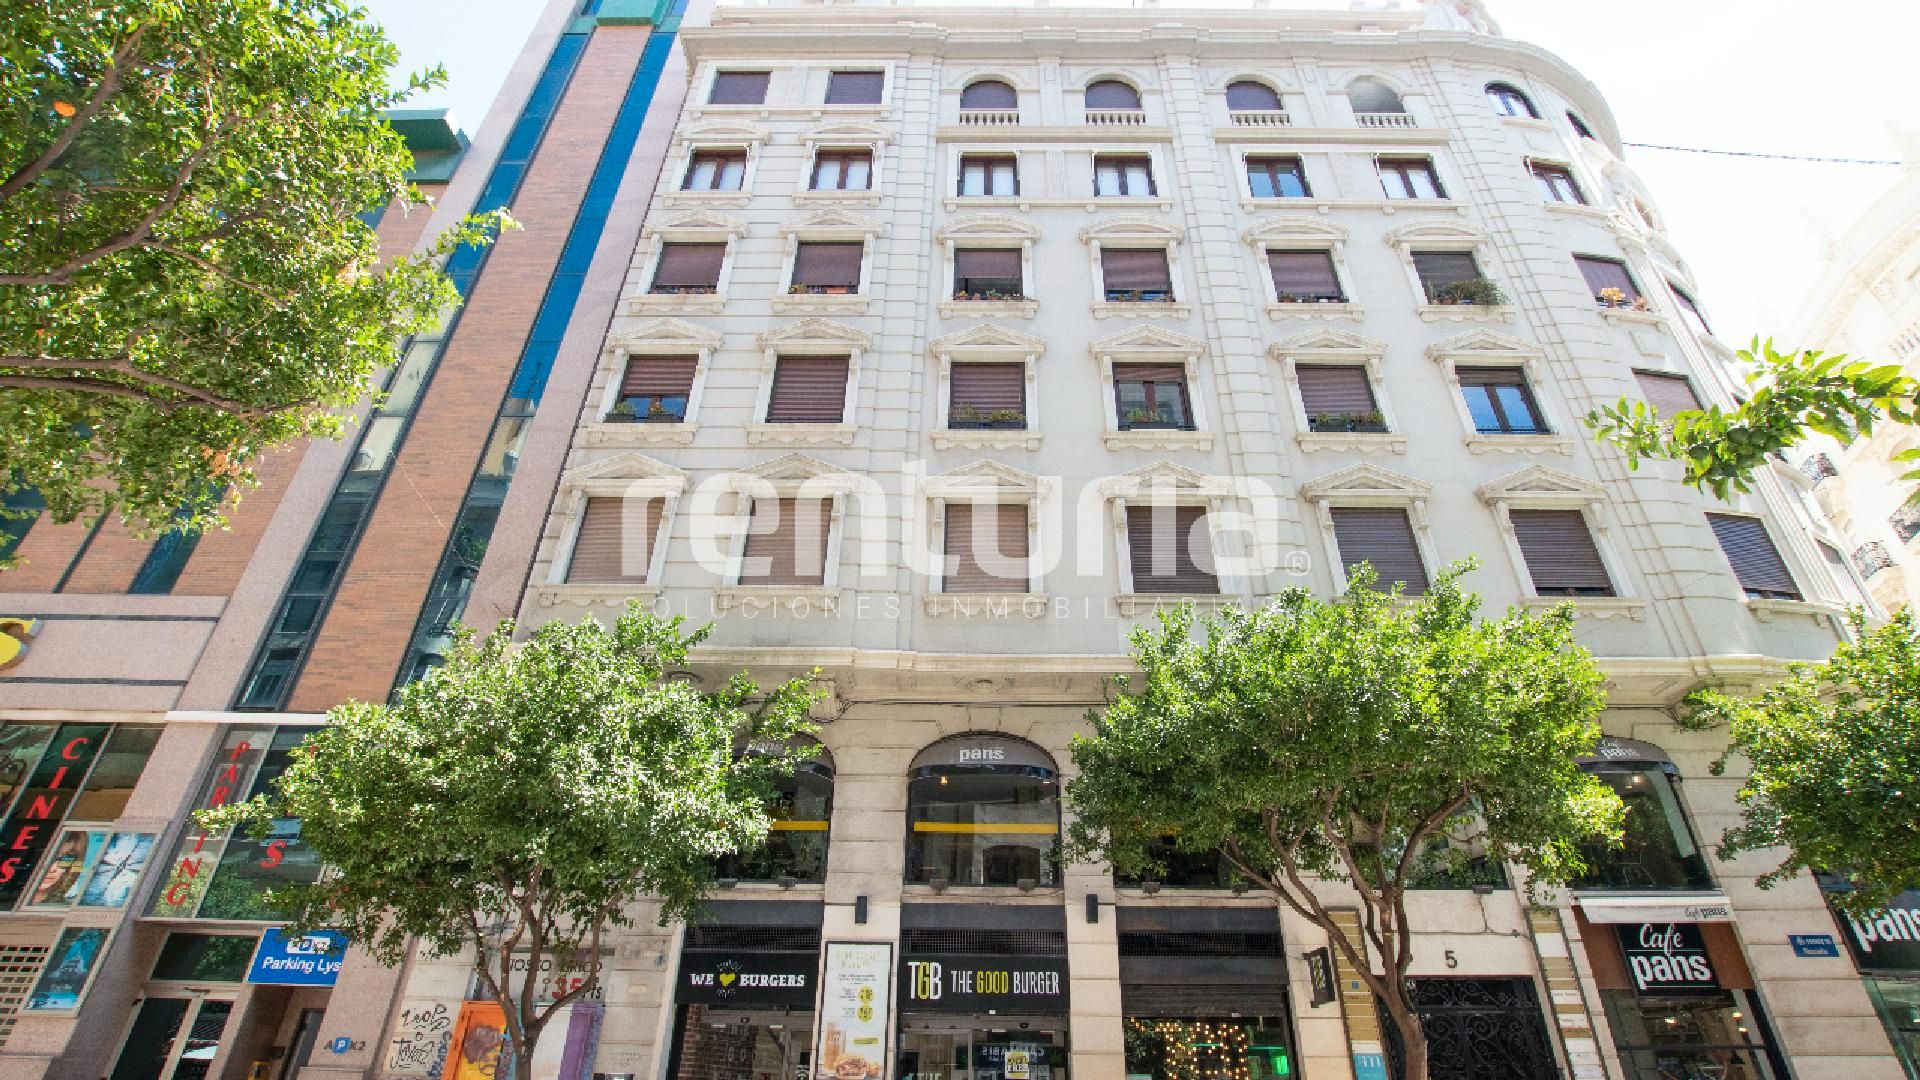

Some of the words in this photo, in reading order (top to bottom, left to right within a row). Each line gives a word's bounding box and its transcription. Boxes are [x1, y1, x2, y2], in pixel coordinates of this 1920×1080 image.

[960, 748, 1004, 763] pans
[0, 737, 89, 883] CINES
[166, 740, 250, 906] PARING
[262, 955, 315, 975] Parking
[1444, 950, 1458, 969] 5
[1630, 955, 1713, 990] pans
[690, 973, 715, 986] WE
[739, 974, 805, 988] BURGERS
[907, 961, 942, 1000] TGB
[950, 970, 973, 994] THE
[976, 970, 1009, 994] GOOD
[1013, 971, 1060, 995] BURGER
